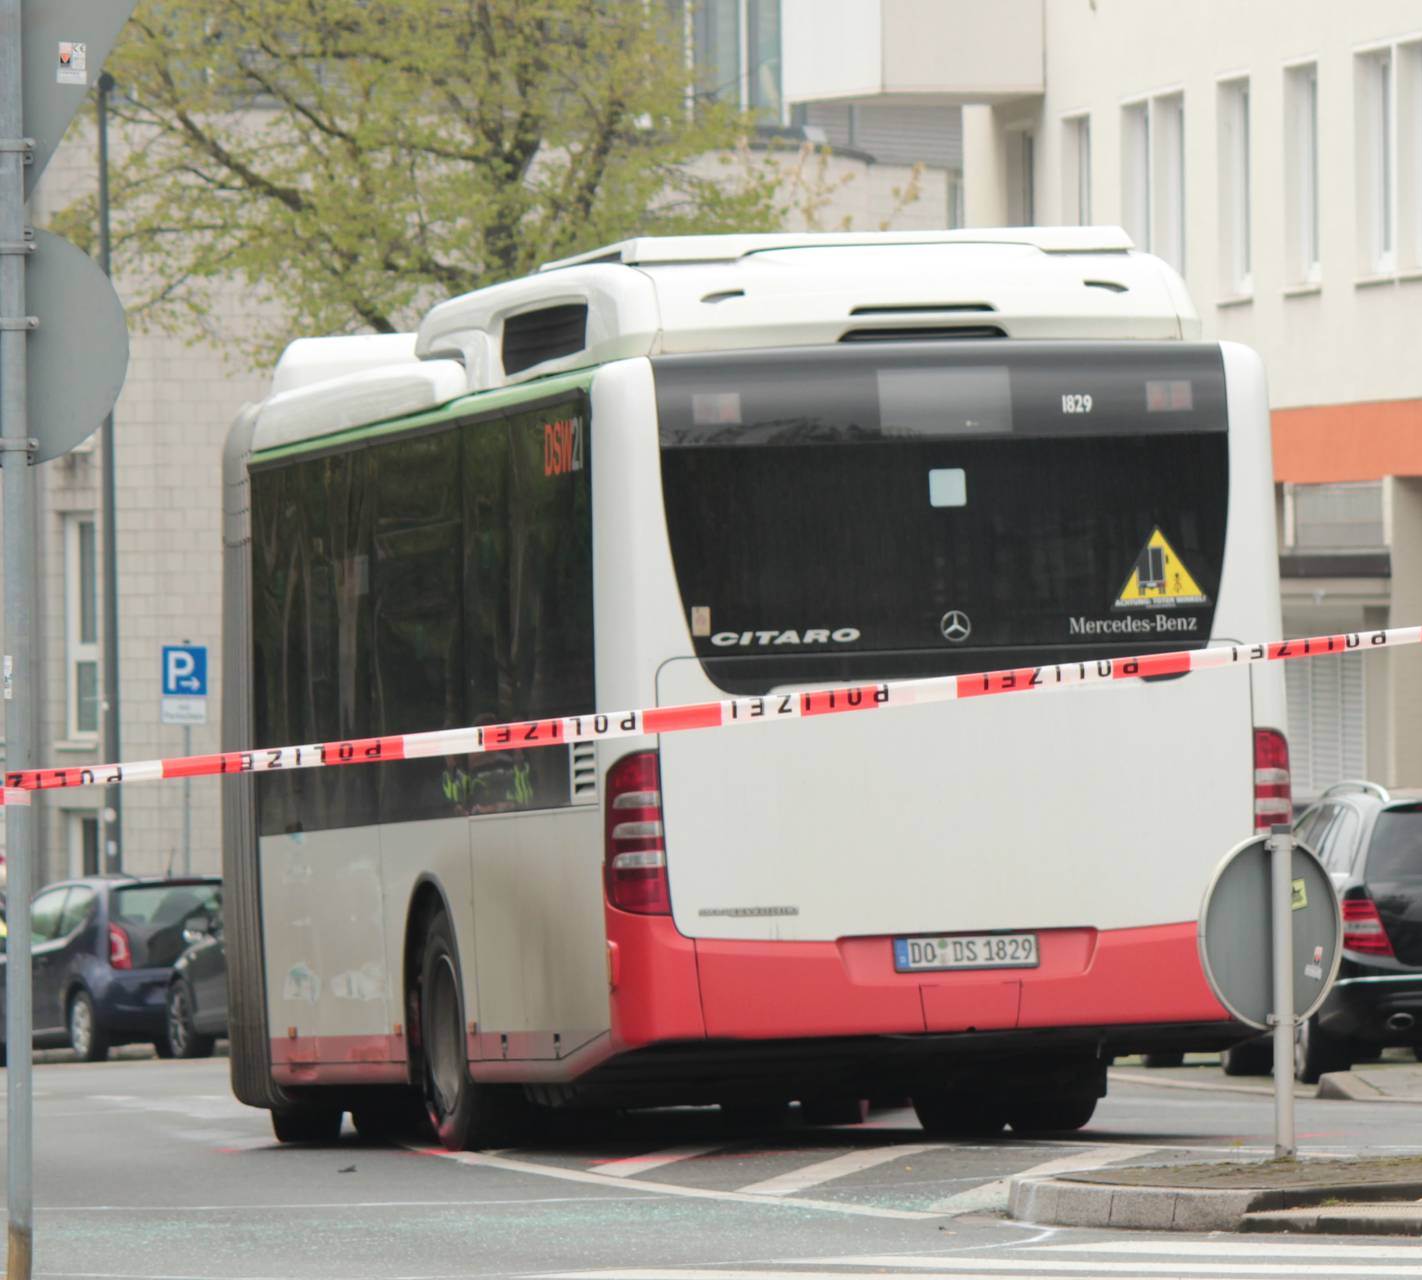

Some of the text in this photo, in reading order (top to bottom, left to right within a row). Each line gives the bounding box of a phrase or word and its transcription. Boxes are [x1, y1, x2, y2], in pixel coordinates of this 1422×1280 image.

[1062, 394, 1093, 414] 1829
[543, 415, 583, 476] DSW21
[711, 628, 861, 646] CITARO
[1069, 614, 1197, 634] Mercedes-Benz
[168, 651, 195, 690] P
[477, 712, 636, 746] POLIZEI
[220, 740, 382, 773] POLIZEI
[910, 938, 1033, 964] DO DS 1829
